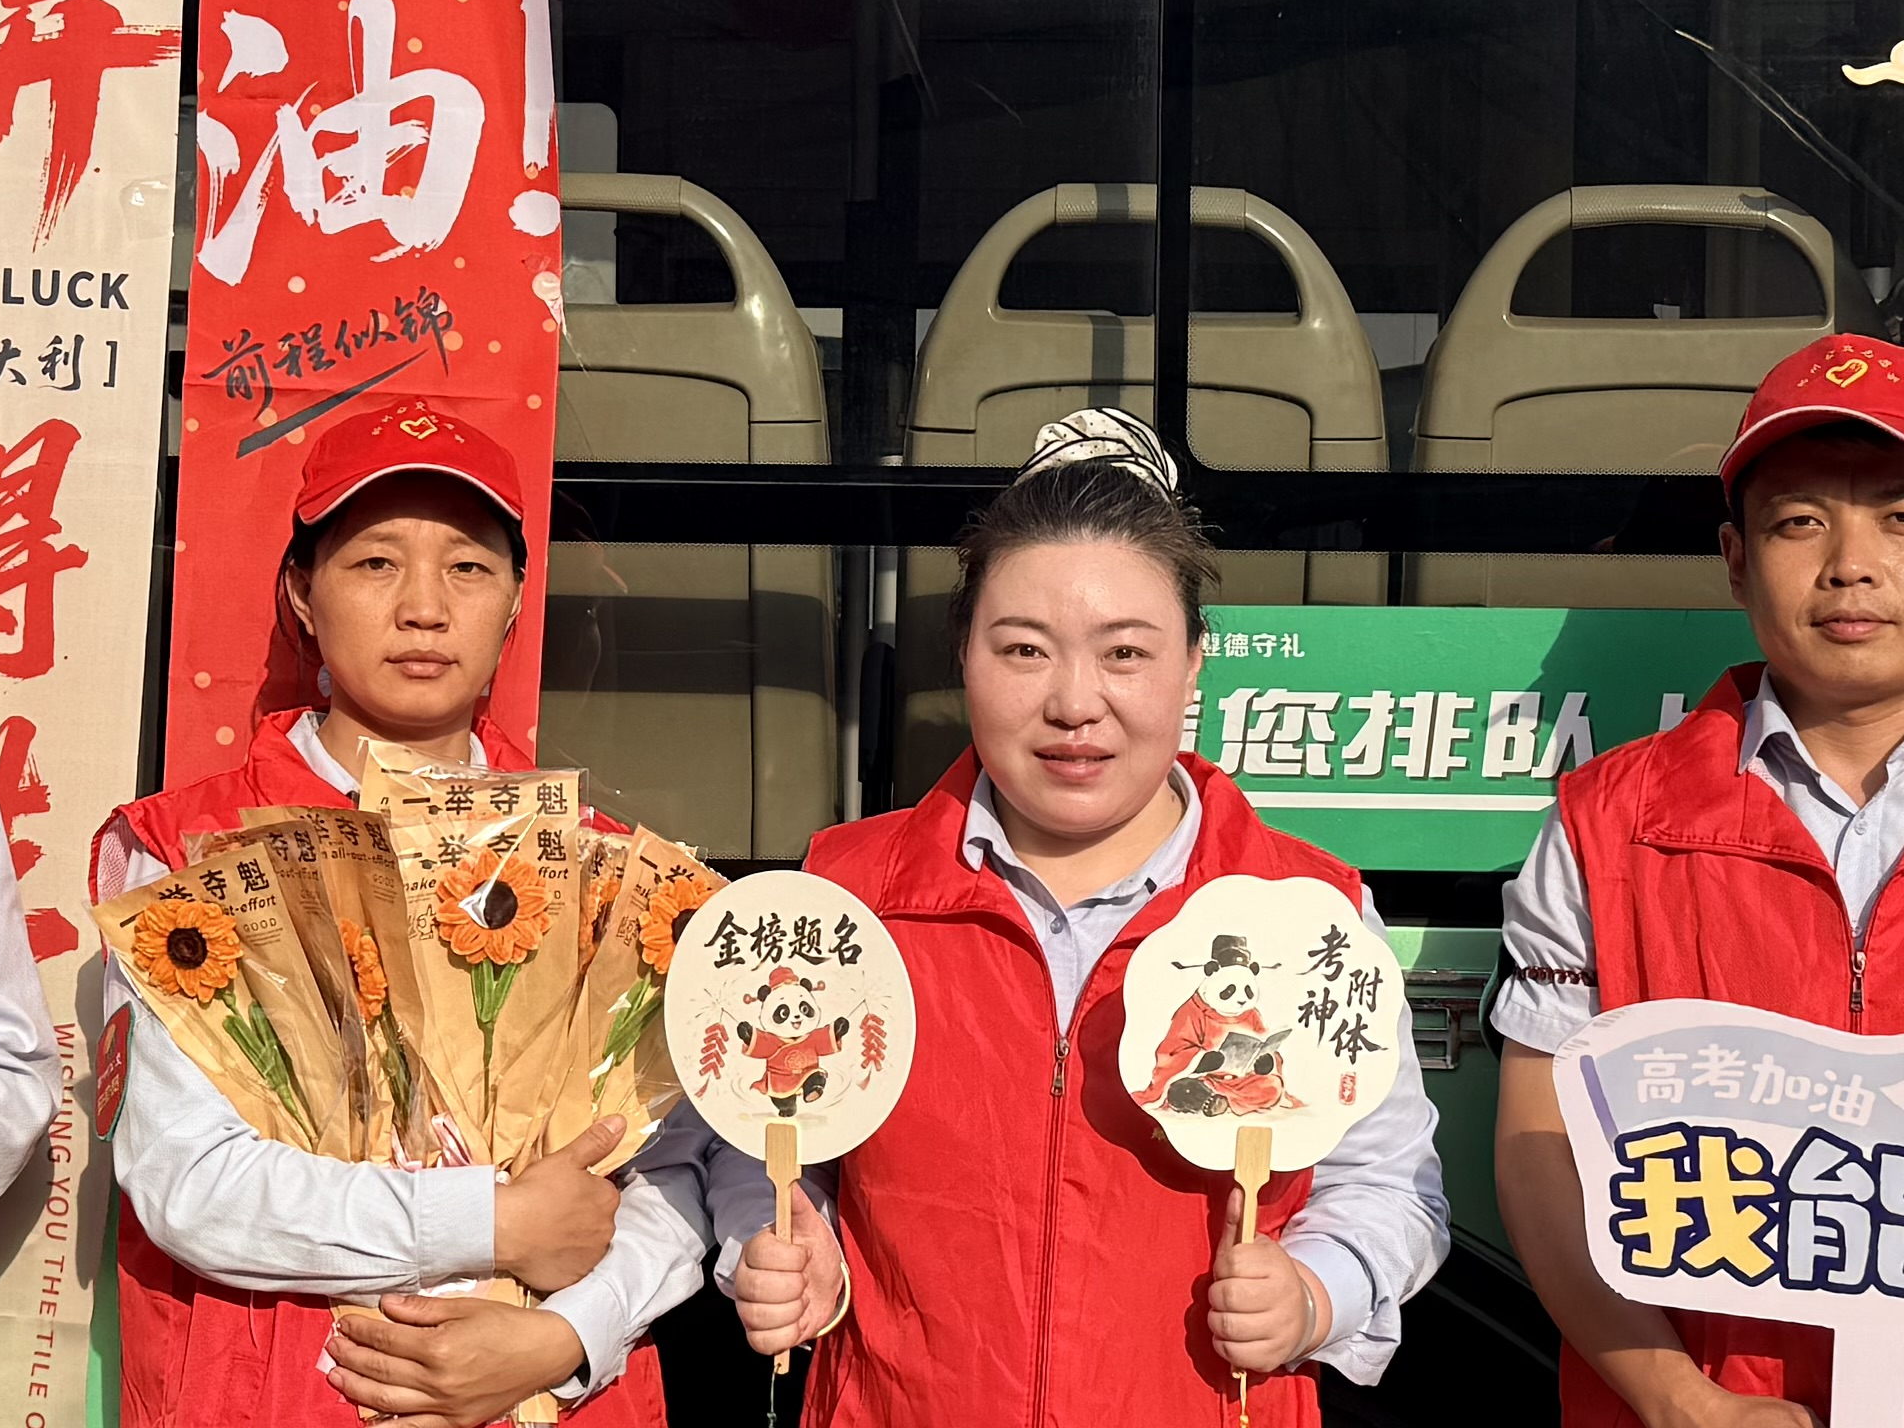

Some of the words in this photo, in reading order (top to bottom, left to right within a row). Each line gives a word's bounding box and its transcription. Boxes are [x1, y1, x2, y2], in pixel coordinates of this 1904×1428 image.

[1, 266, 130, 311] LUCK
[201, 286, 454, 420] 前程似锦
[1180, 687, 1688, 779] 您排队
[403, 782, 568, 816] 一举夺魁
[704, 910, 863, 971] 金榜题名
[1632, 1043, 1877, 1126] 高考加油
[45, 1177, 71, 1242] YOU
[40, 1255, 64, 1317] THE
[28, 1331, 56, 1399] TILE
